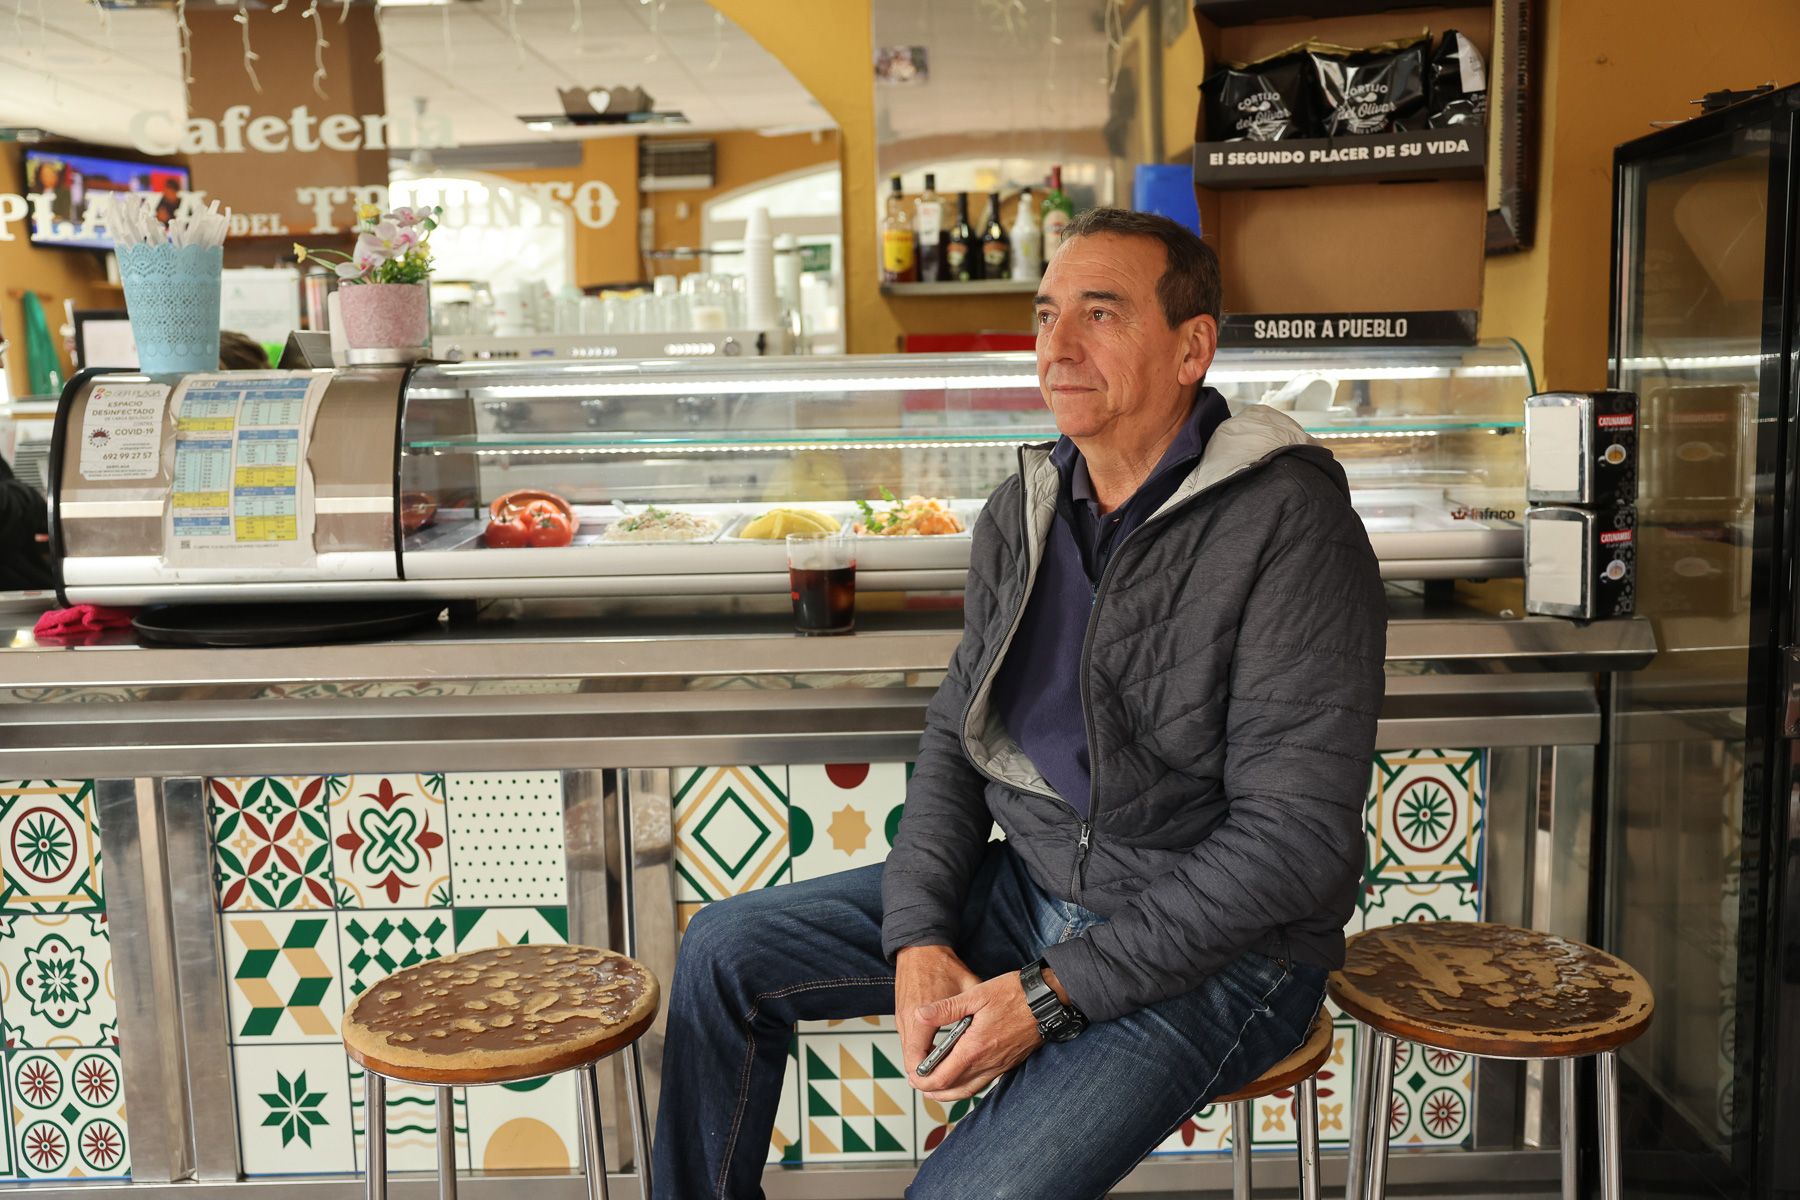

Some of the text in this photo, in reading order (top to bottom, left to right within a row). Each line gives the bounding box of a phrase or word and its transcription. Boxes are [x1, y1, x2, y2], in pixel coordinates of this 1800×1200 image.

[1344, 83, 1389, 97] ORTIJO
[1238, 92, 1281, 110] CORTIJO
[1227, 150, 1305, 165] SEGUNDO
[1310, 147, 1370, 163] PLACER
[1374, 145, 1396, 159] DE
[1400, 142, 1422, 157] SU
[1426, 139, 1470, 155] VIDA
[231, 212, 289, 236] DEL
[1254, 318, 1408, 339] SABOR A PUEBLO
[92, 408, 155, 416] DESINFECTADO
